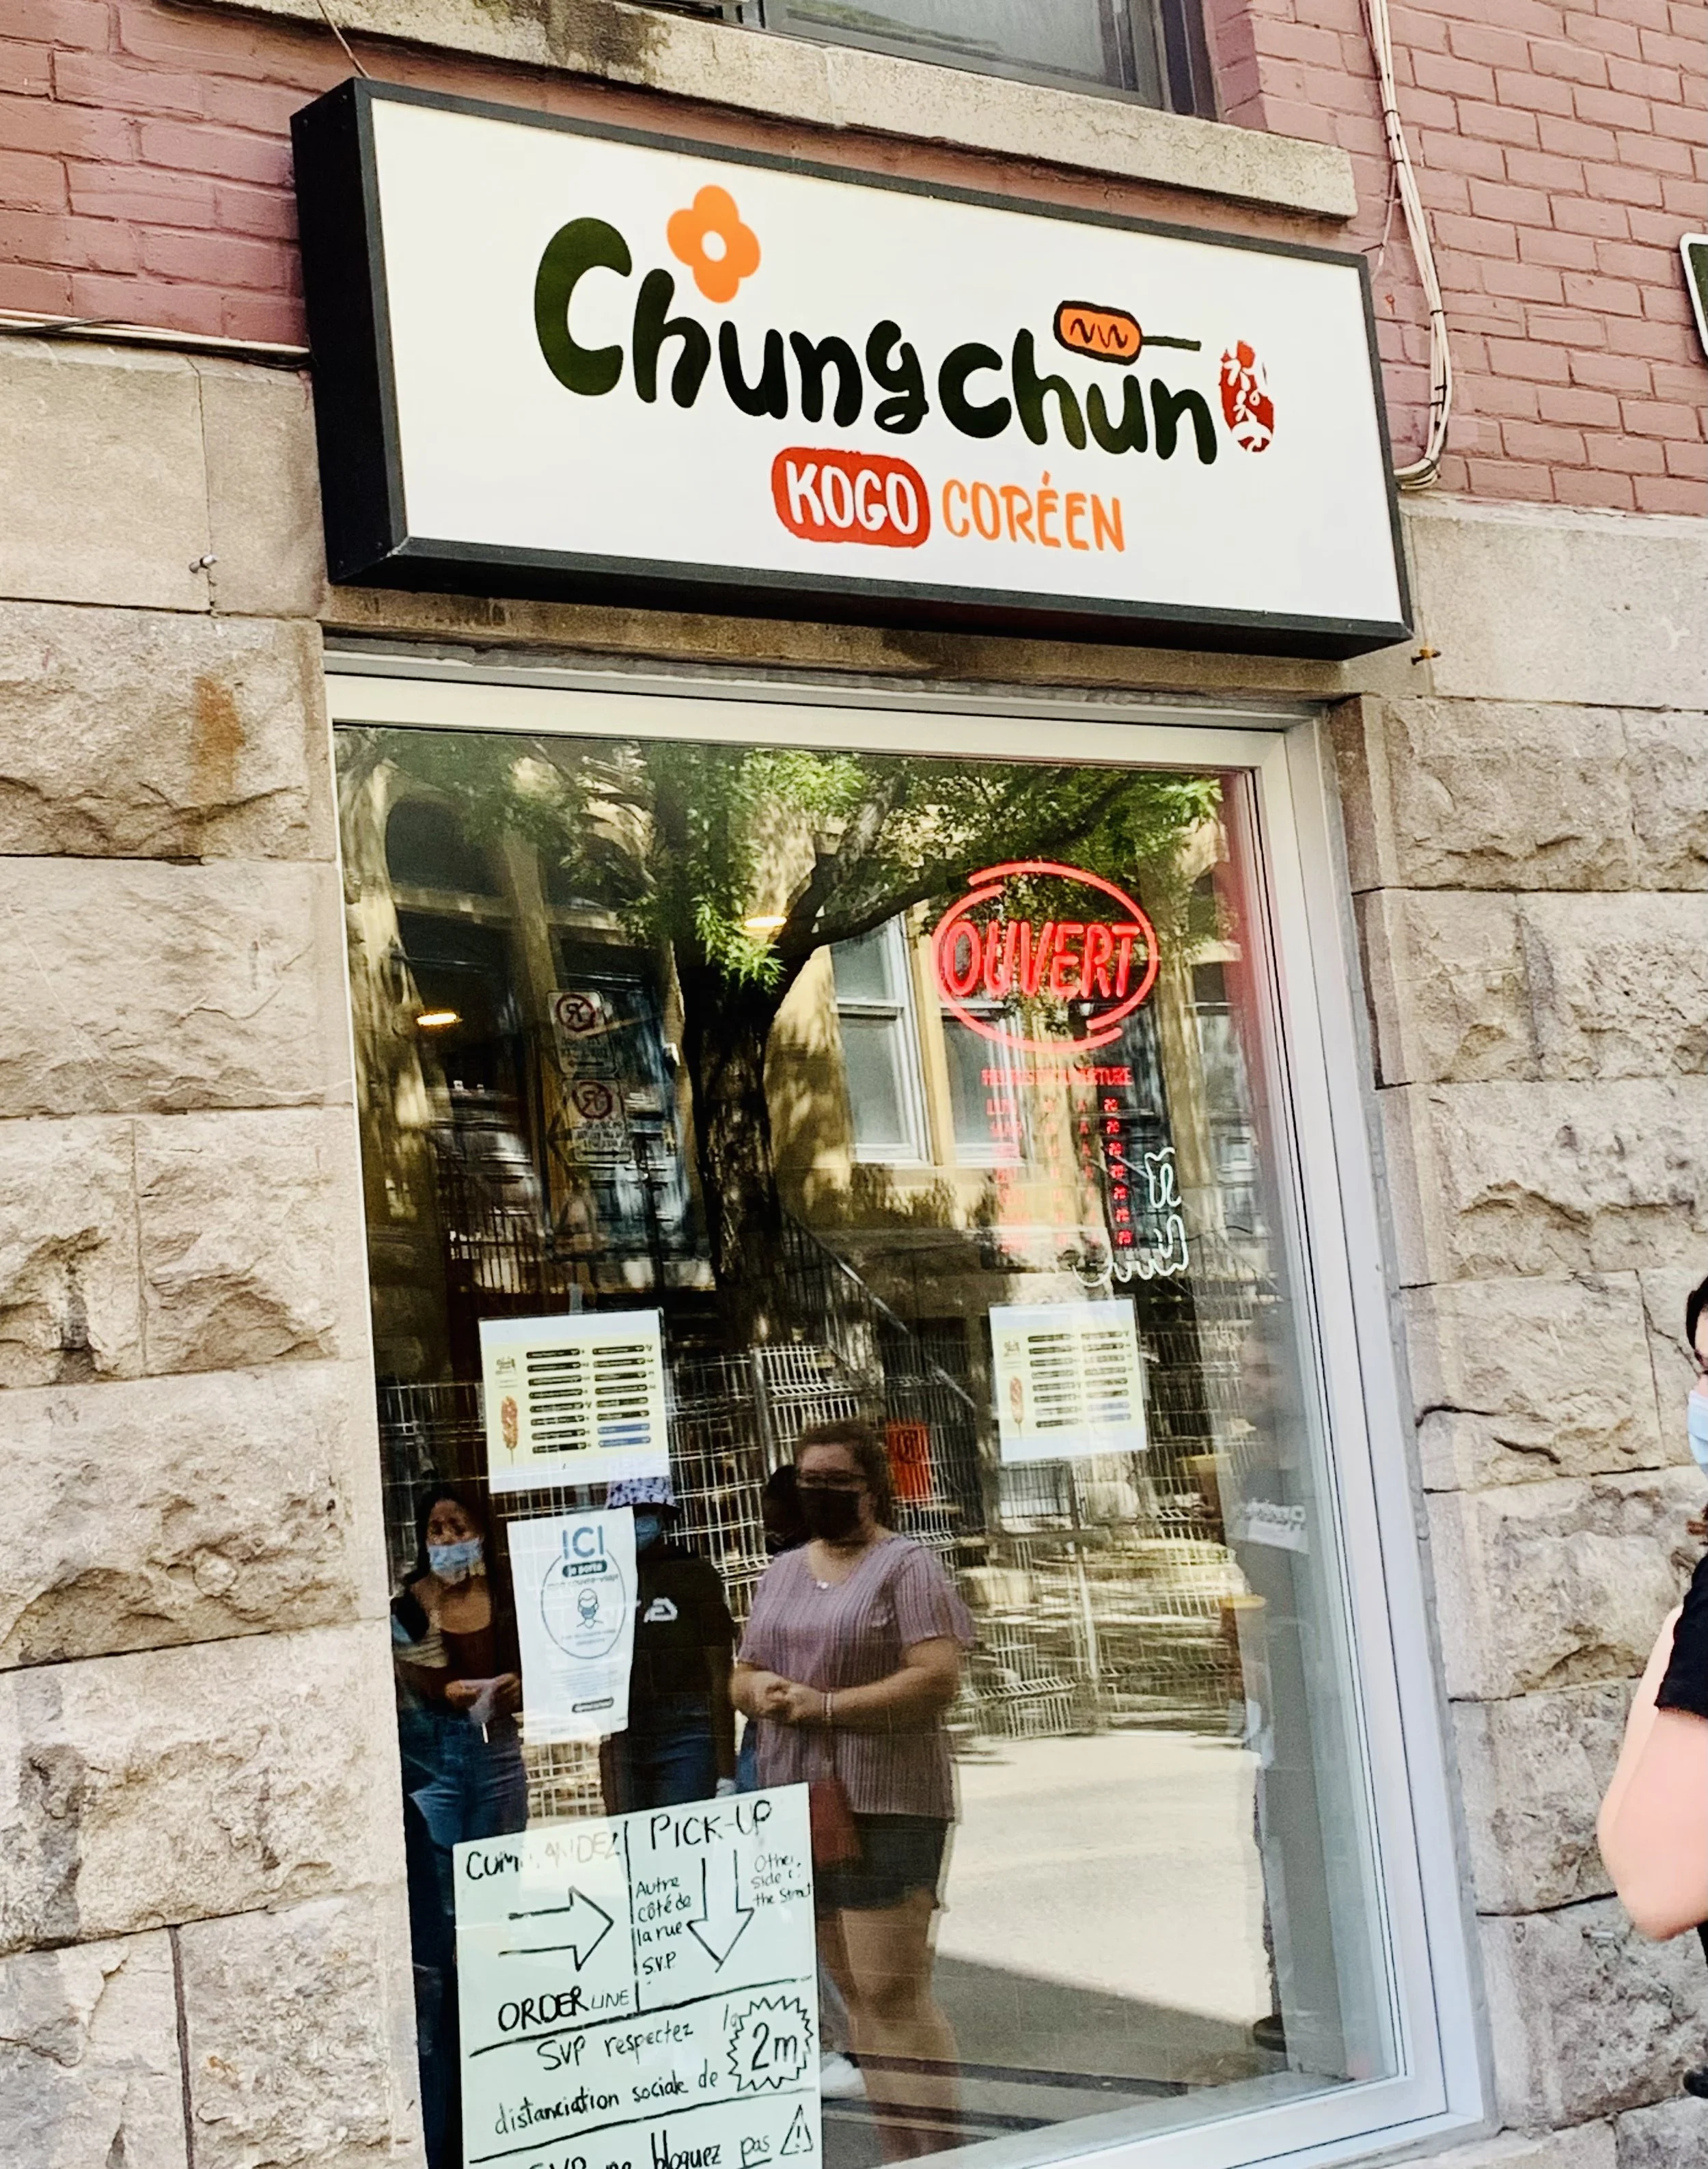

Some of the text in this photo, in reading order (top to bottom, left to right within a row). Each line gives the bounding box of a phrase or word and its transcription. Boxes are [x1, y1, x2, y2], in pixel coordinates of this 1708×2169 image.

[534, 217, 1218, 465] Chungchun
[784, 461, 1126, 552] KOGO CORÉEN
[941, 918, 1141, 998] OUVERT
[562, 1525, 605, 1559] ICI
[651, 1799, 772, 1850] PICK-UP
[636, 1877, 680, 1898] Autre
[750, 1872, 782, 1890] side
[752, 1892, 775, 1907] the
[637, 1892, 691, 1923] côté de
[637, 1920, 683, 1946] la rue
[497, 1985, 590, 2032] ORDER
[536, 2035, 586, 2071] SVP
[604, 2019, 694, 2064] respectez
[495, 2022, 798, 2135] distanciation sociale de 2m
[740, 2135, 771, 2166] pas
